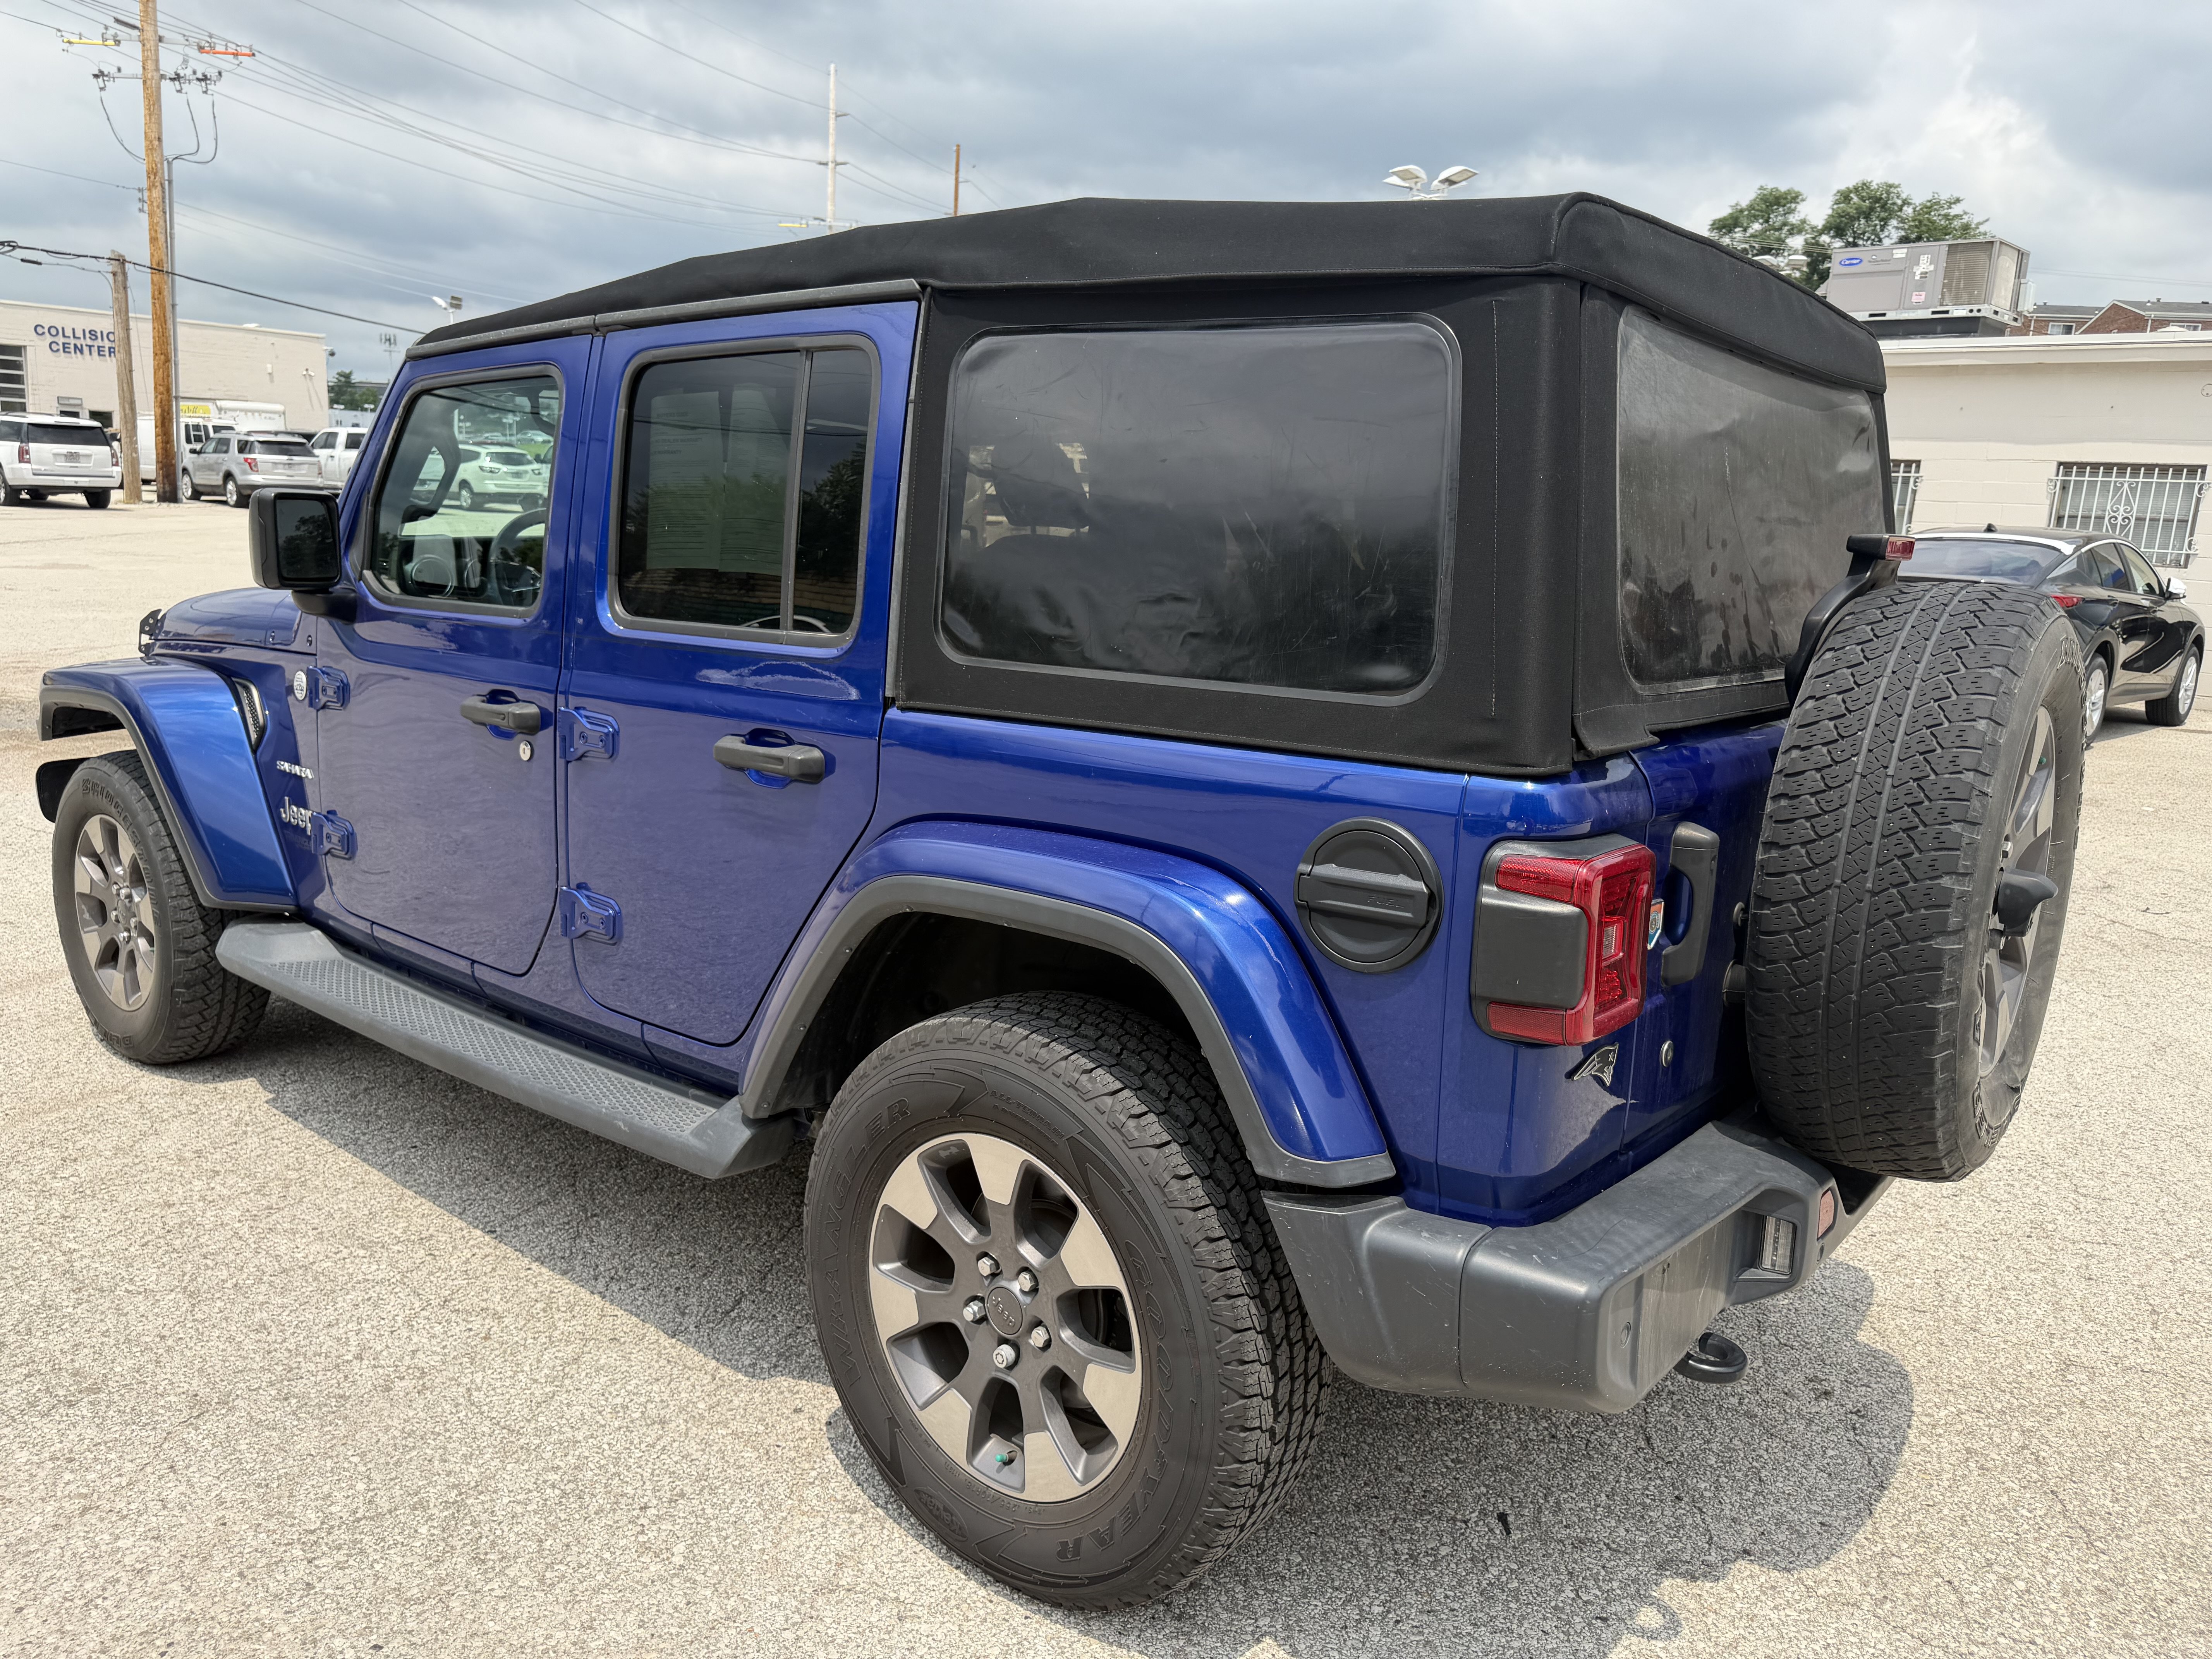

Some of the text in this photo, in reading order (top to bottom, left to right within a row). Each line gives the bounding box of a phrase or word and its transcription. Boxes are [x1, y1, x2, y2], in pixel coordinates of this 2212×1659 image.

[34, 323, 115, 343] COLLISIO
[48, 340, 116, 357] CENTER
[276, 760, 314, 779] SAHARA
[1367, 896, 1404, 908] FUEL
[821, 1095, 913, 1387] WRANGLER
[992, 1296, 1016, 1328] Jeep
[1052, 1234, 1175, 1563] GOODYEAR
